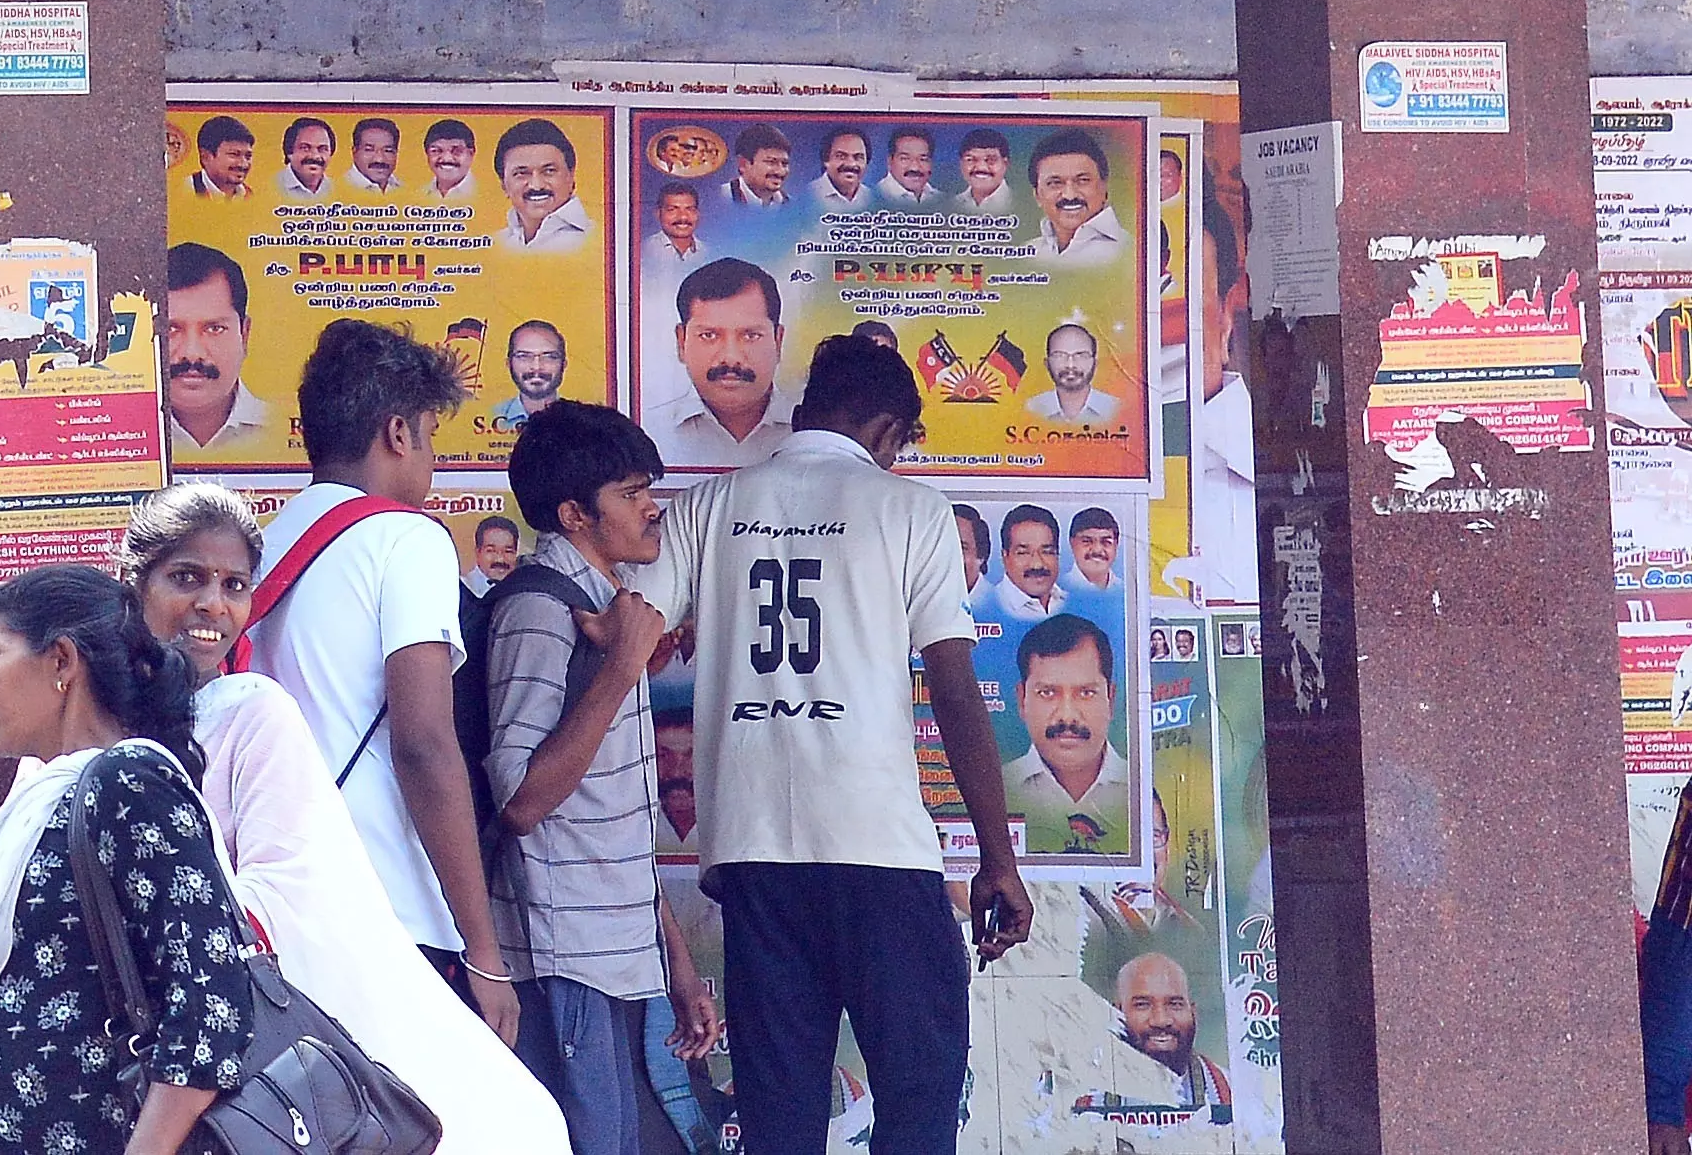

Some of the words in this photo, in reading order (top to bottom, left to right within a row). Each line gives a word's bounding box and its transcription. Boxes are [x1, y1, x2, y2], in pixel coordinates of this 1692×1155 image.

[34, 8, 81, 17] HOSPITAL
[29, 41, 68, 50] Treatment
[1366, 49, 1412, 58] MALAIVEL
[1416, 49, 1450, 57] SIDDHA
[1454, 49, 1499, 57] HOSPITAL
[17, 57, 49, 69] 83444
[52, 56, 83, 69] 77793
[1420, 96, 1433, 107] 91
[1439, 96, 1469, 107] 83444
[1472, 95, 1503, 108] 77793
[1601, 117, 1627, 127] 1972
[1639, 117, 1663, 127] 2022
[1258, 142, 1275, 158] JOB
[1277, 136, 1319, 157] VACANCY
[404, 206, 473, 219] (தெற்கு)
[282, 220, 347, 233] ஒன்றிய
[353, 221, 465, 233] செயலாளராக
[950, 214, 1019, 228] (தெற்கு)
[829, 229, 893, 242] ஒன்றிய
[898, 229, 1010, 242] செயலாளராக
[294, 282, 354, 293] ஒன்றிய
[360, 283, 396, 293] பணி
[401, 283, 454, 293] சிறக்க
[840, 289, 900, 301] ஒன்றிய
[905, 290, 942, 301] பணி
[1506, 414, 1558, 425] COMPANY
[732, 521, 847, 539] Dhayanithi
[20, 545, 78, 556] CLOTHING
[749, 558, 822, 675] 35
[732, 700, 845, 721] RNR
